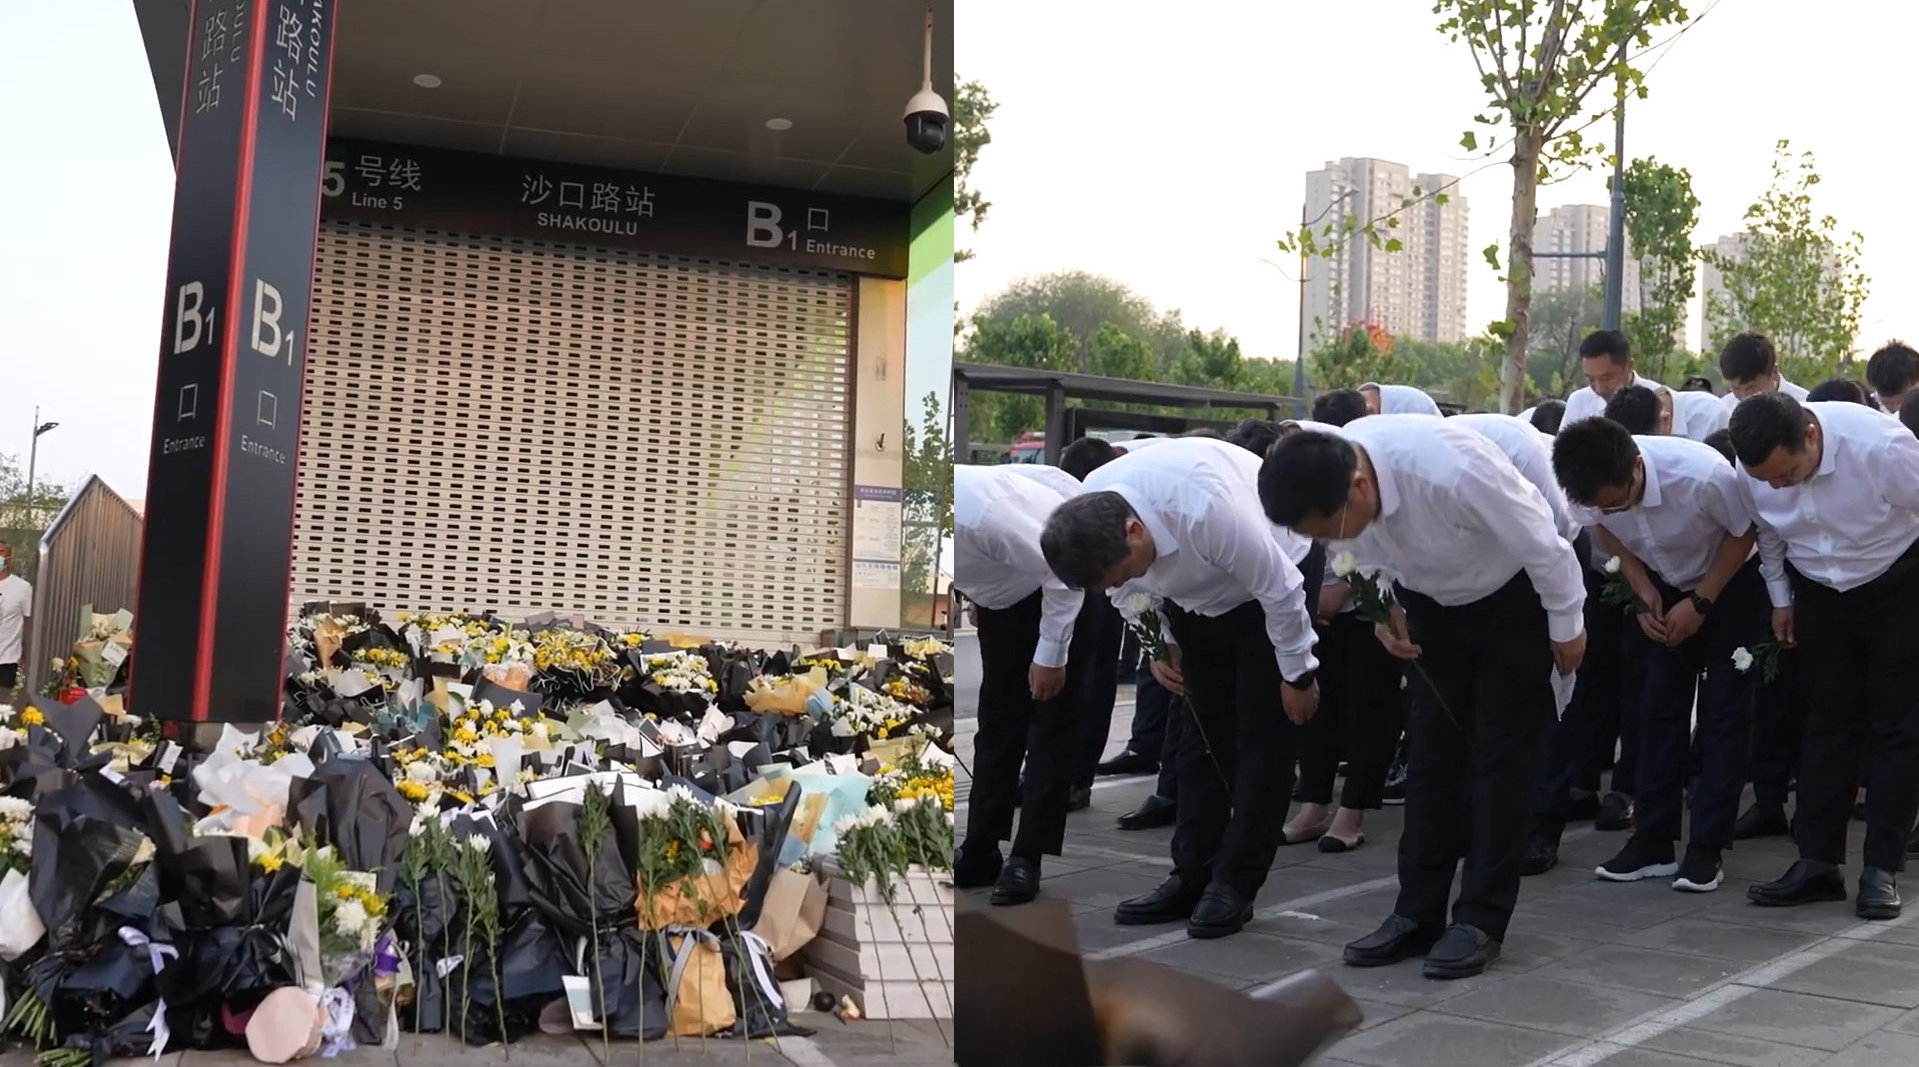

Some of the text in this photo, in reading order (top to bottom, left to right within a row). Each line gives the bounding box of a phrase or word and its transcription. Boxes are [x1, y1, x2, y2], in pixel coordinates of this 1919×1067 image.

[196, 9, 227, 113] 路站
[272, 4, 303, 121] 路站
[352, 191, 403, 211] Line 5
[521, 174, 656, 218] 沙口路站
[536, 212, 639, 237] SHAKOULU
[805, 239, 876, 260] Entrance
[163, 435, 205, 454] Entrance
[241, 435, 286, 464] Entrance
